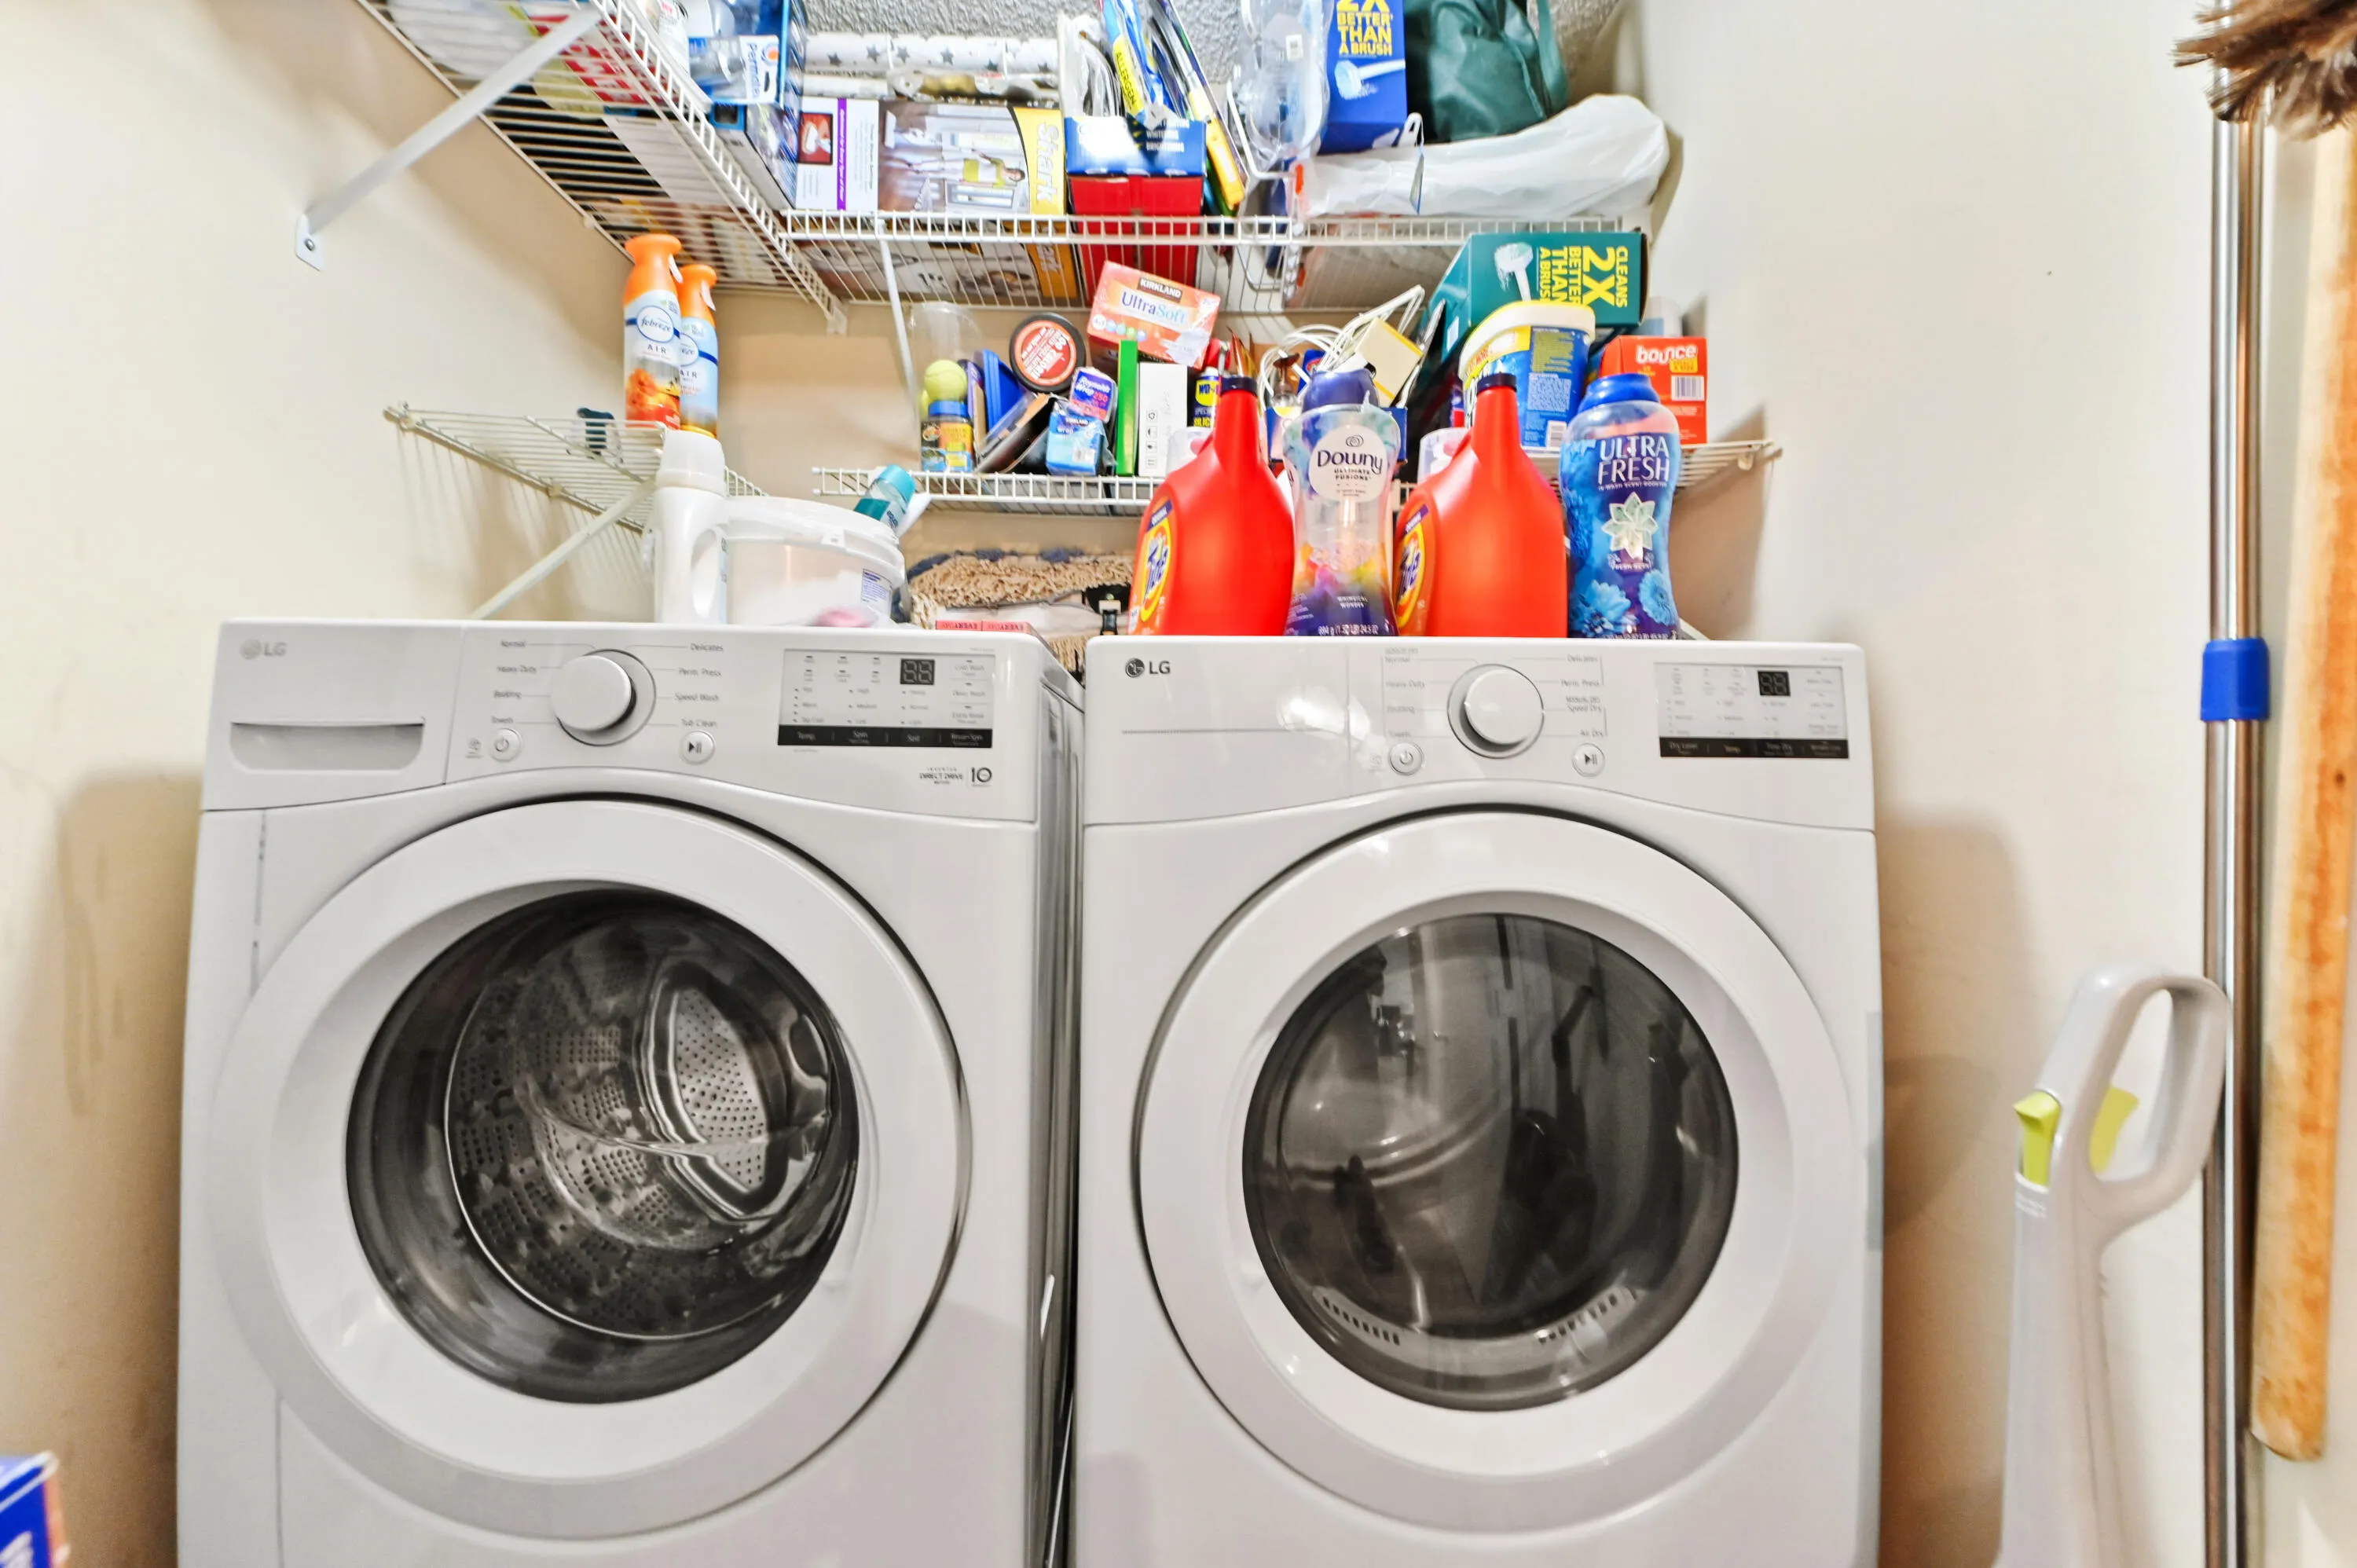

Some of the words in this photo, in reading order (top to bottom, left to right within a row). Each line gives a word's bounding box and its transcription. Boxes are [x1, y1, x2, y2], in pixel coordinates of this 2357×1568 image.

[1338, 26, 1392, 43] THAN
[1339, 43, 1349, 55] A
[1351, 43, 1392, 56] BRUSH
[1115, 51, 1137, 105] ALLERGEN
[1036, 123, 1059, 203] Shark
[1582, 245, 1615, 307] 2X
[1615, 245, 1629, 308] CLEANS
[1139, 277, 1182, 299] KIRKLAND
[1121, 291, 1187, 324] UltraSoft
[640, 314, 672, 332] febreze
[647, 344, 667, 354] AIR
[1635, 344, 1697, 365] bounce
[680, 368, 698, 378] AIR
[1600, 434, 1670, 461] ULTRA
[1317, 449, 1383, 475] Downy
[1598, 456, 1670, 485] FRESH
[263, 642, 288, 657] LG
[1149, 660, 1171, 674] LG
